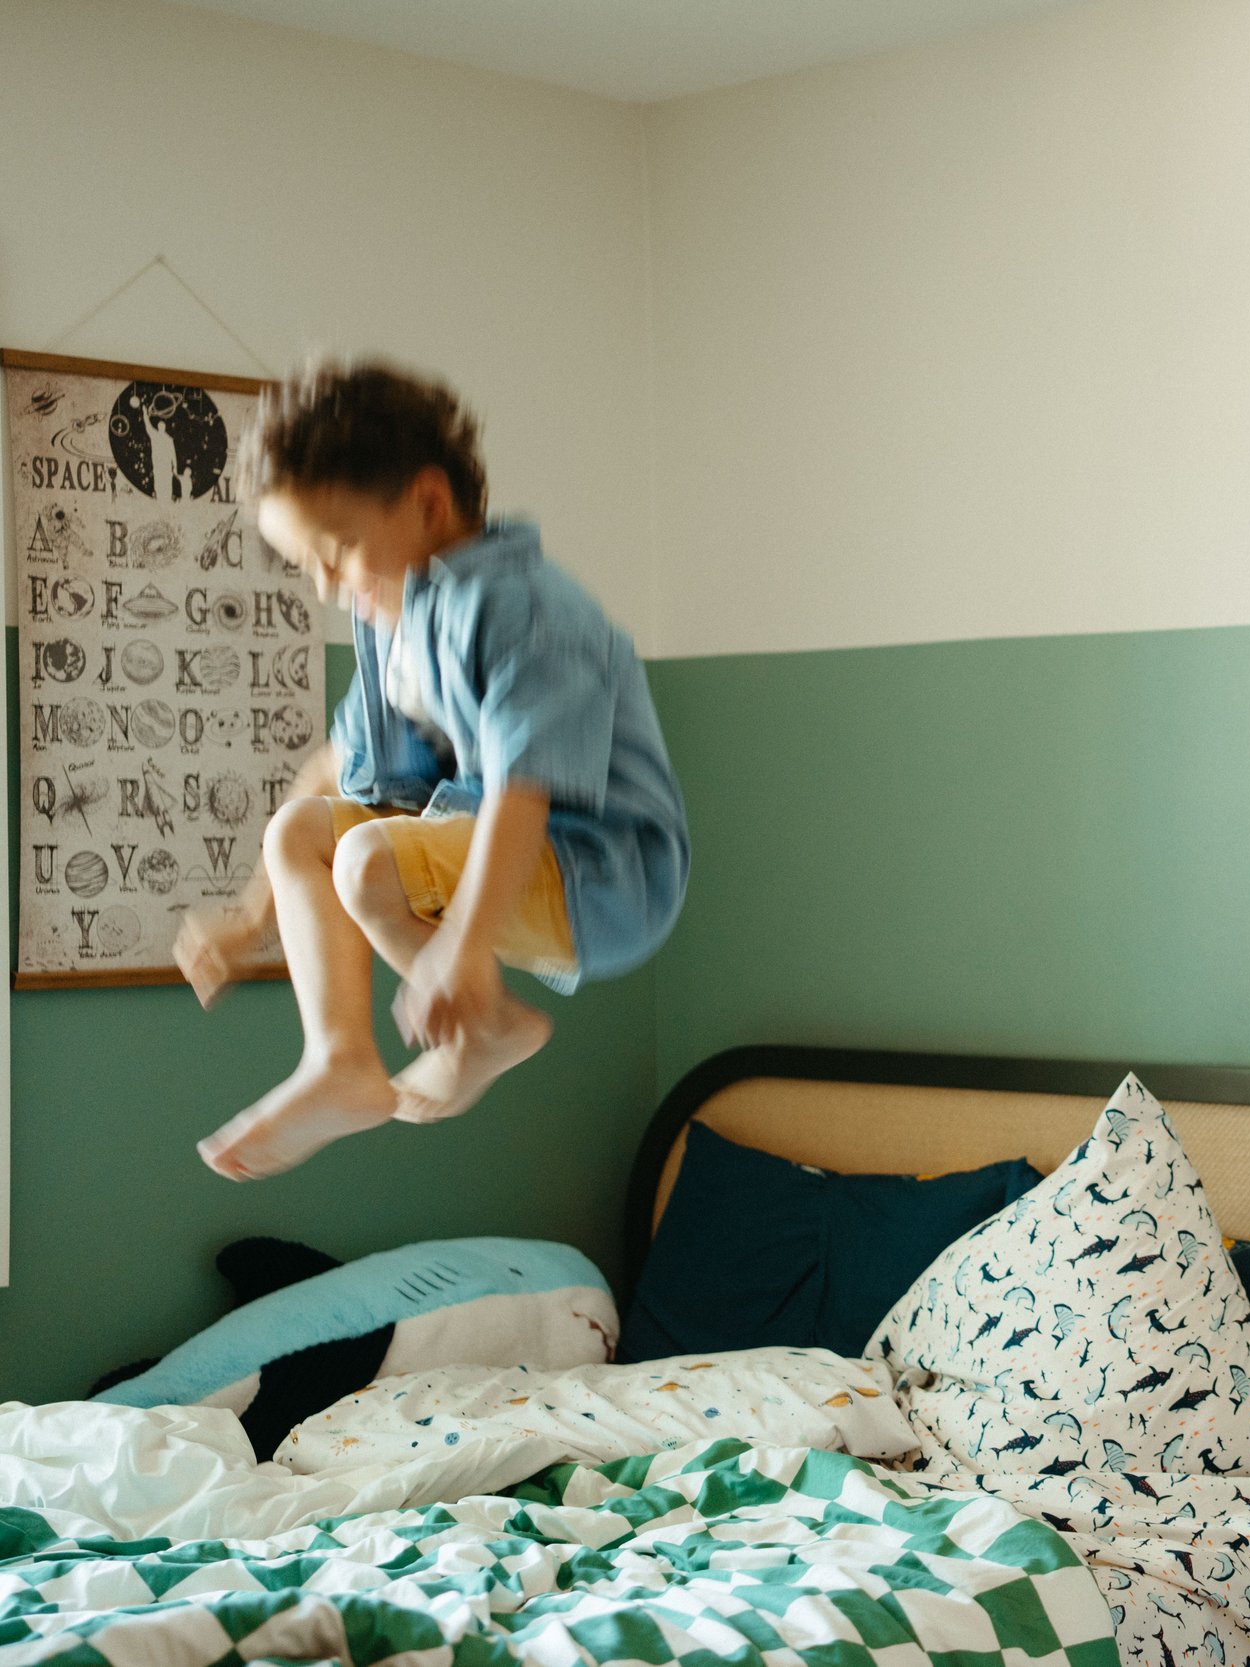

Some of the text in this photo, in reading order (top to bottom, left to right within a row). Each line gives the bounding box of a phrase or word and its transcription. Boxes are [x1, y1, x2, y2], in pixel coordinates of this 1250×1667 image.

[32, 456, 106, 492] SPACE
[27, 513, 53, 553] A
[104, 519, 128, 559] B
[221, 529, 243, 569] C
[28, 574, 48, 615] E
[101, 580, 122, 619] F
[185, 587, 210, 626] G
[252, 590, 277, 628] H
[32, 641, 45, 681] I
[98, 646, 116, 685] J
[175, 649, 202, 687] K
[249, 650, 270, 688] L
[32, 703, 62, 743] M
[106, 703, 131, 744] N
[179, 708, 204, 745] O
[251, 708, 270, 746] P
[32, 776, 56, 824] Q
[117, 778, 144, 818] R
[184, 773, 200, 813] S
[32, 844, 58, 884] U
[111, 844, 138, 885] V
[203, 836, 236, 875] W
[71, 906, 99, 949] Y
